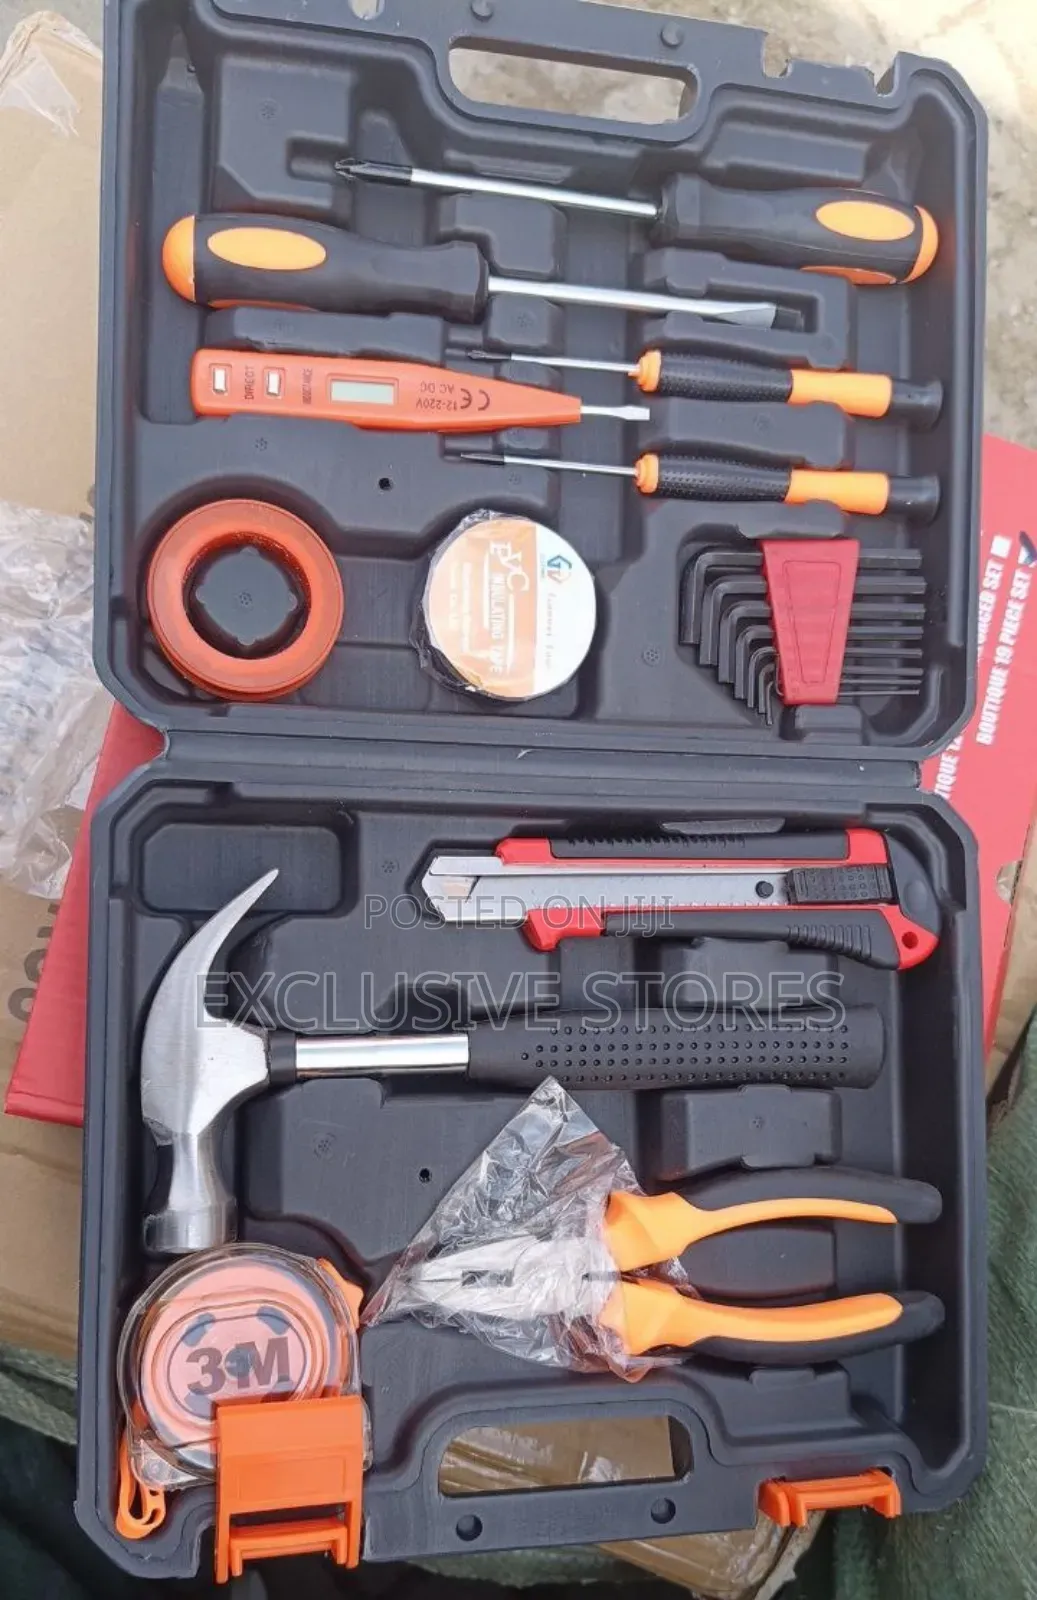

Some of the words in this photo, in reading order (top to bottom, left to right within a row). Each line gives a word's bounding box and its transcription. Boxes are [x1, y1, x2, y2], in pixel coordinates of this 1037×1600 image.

[244, 365, 255, 400] DIRECT
[420, 381, 436, 394] DC
[439, 383, 455, 395] AC
[415, 397, 458, 412] 12-220V
[489, 540, 530, 592] PVC
[982, 559, 1005, 591] SET
[488, 572, 507, 640] INSULATING
[488, 645, 506, 674] TAPE
[976, 666, 1010, 746] BOUTIQUE
[993, 644, 1015, 666] 19
[1010, 567, 1033, 600] SET
[186, 1336, 291, 1396] 3M
